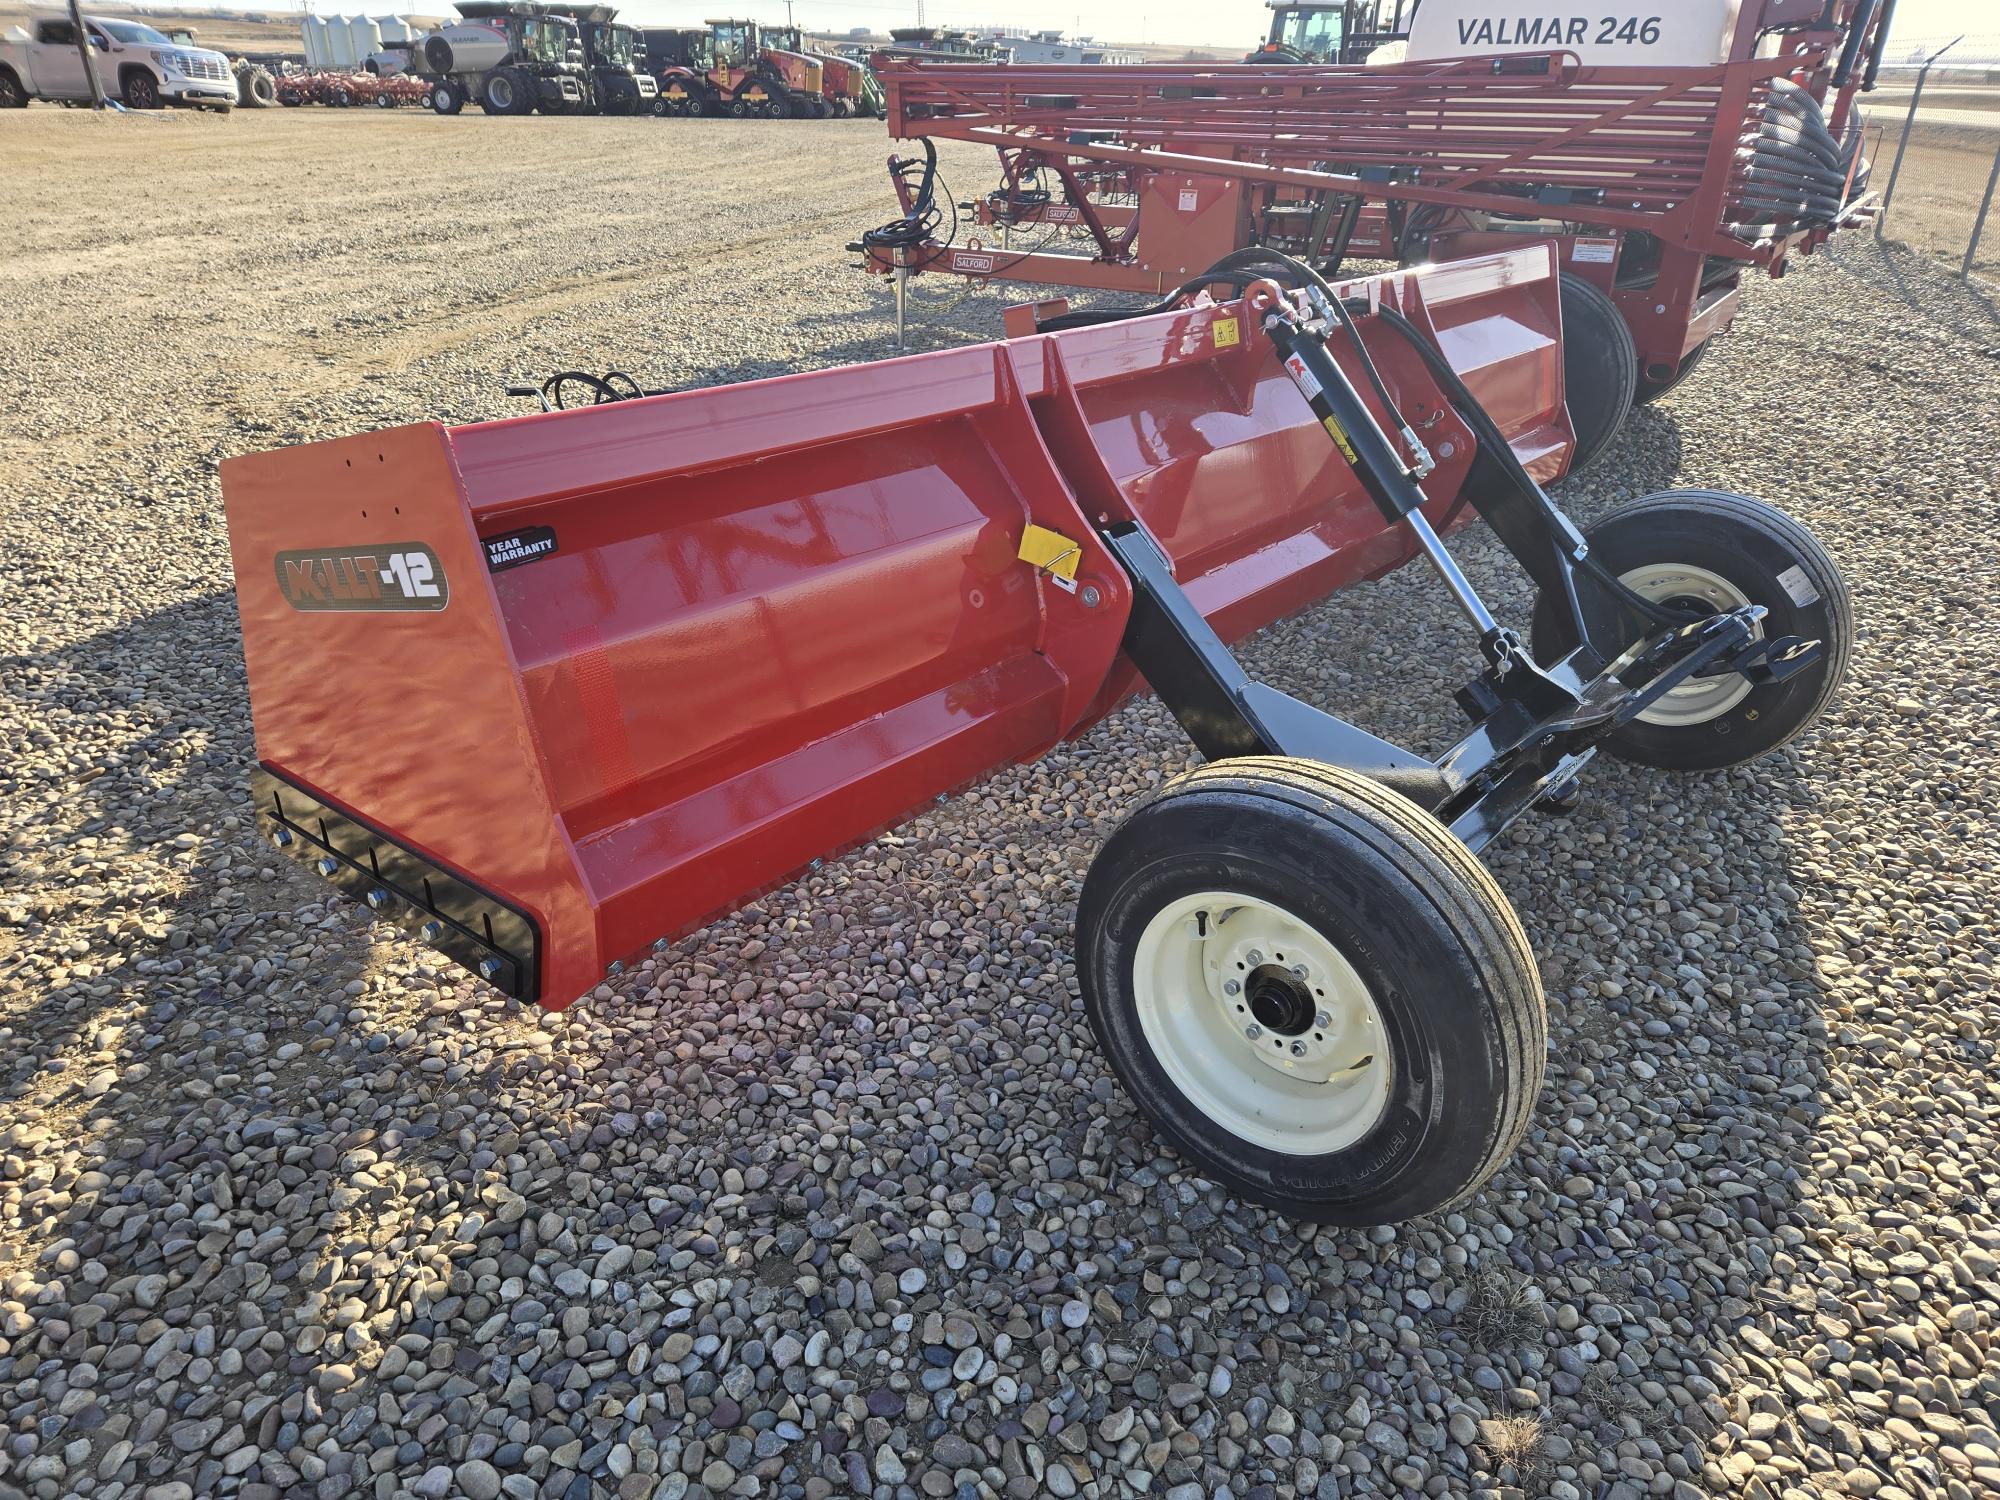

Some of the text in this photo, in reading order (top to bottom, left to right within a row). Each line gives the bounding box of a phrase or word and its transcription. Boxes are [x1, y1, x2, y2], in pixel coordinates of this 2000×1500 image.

[1457, 16, 1662, 45] VALMAR 246
[1048, 209, 1076, 219] SALFORD
[956, 256, 990, 270] SALFORD
[488, 537, 521, 554] YEAR
[490, 538, 552, 564] WARRANTY
